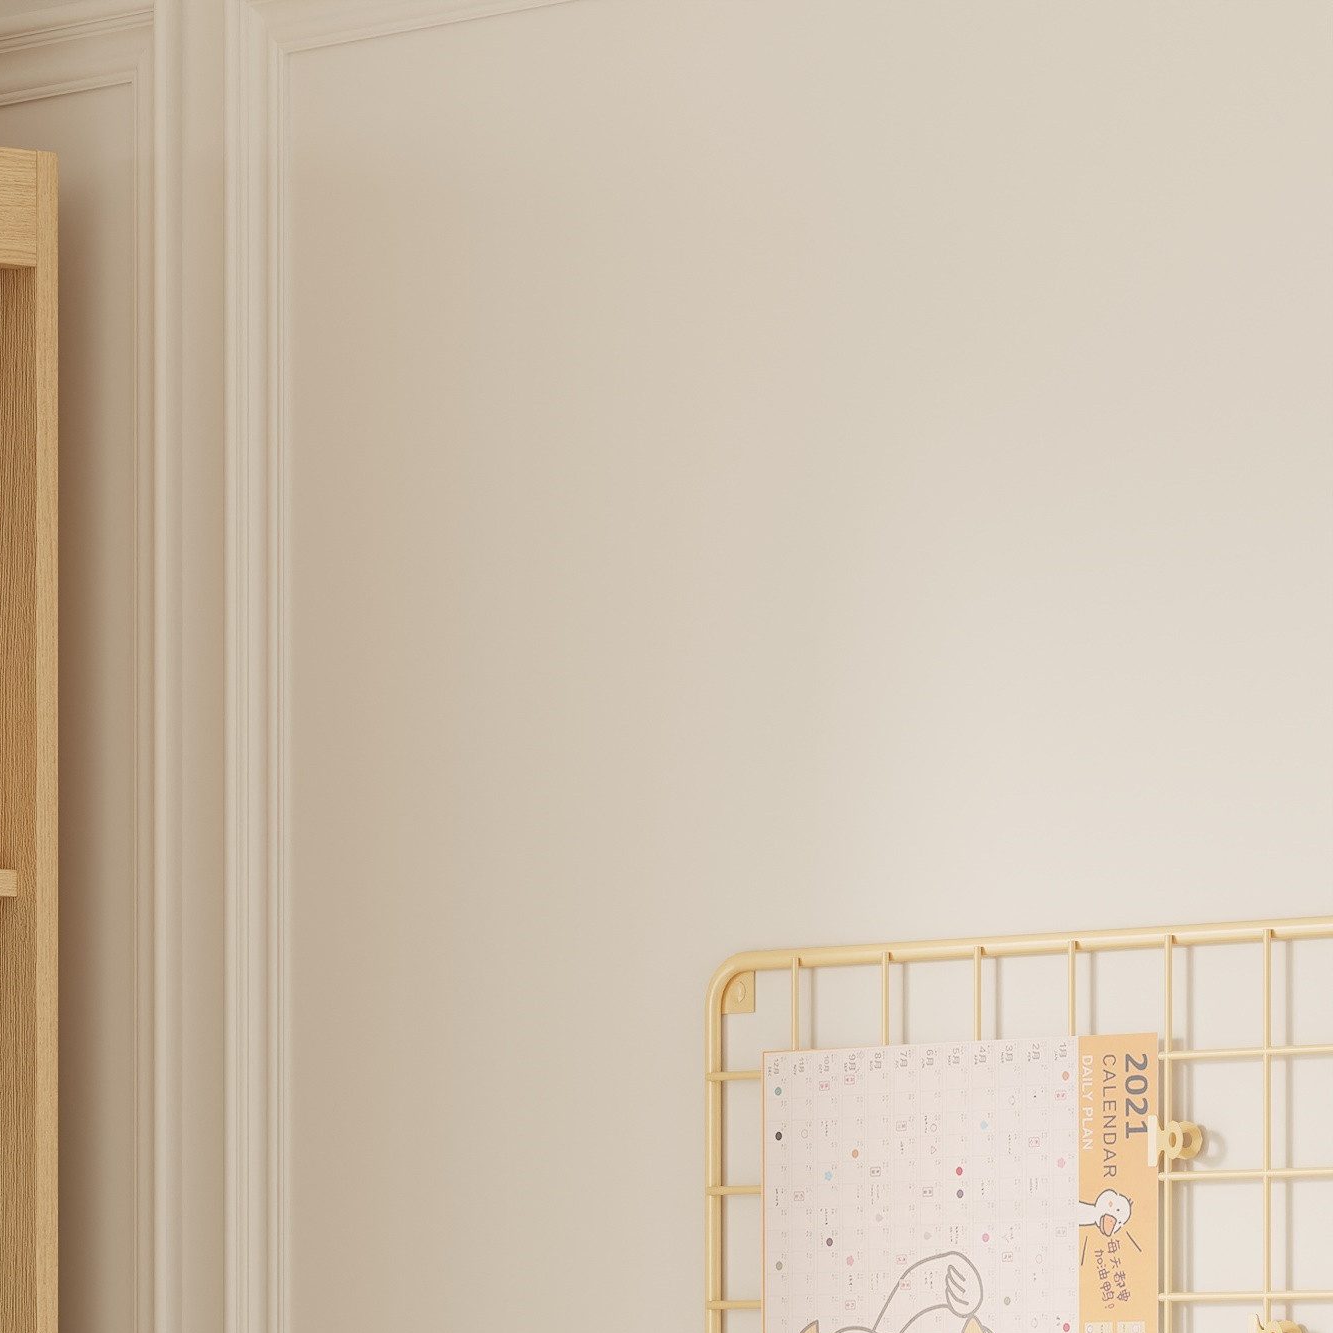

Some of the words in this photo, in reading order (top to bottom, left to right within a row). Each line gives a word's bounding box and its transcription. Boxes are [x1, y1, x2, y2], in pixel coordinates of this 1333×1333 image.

[1082, 1055, 1093, 1099] DAILY
[1125, 1053, 1148, 1139] 2021
[1083, 1107, 1093, 1150] PLAN
[1103, 1054, 1117, 1178] CALENDAR
